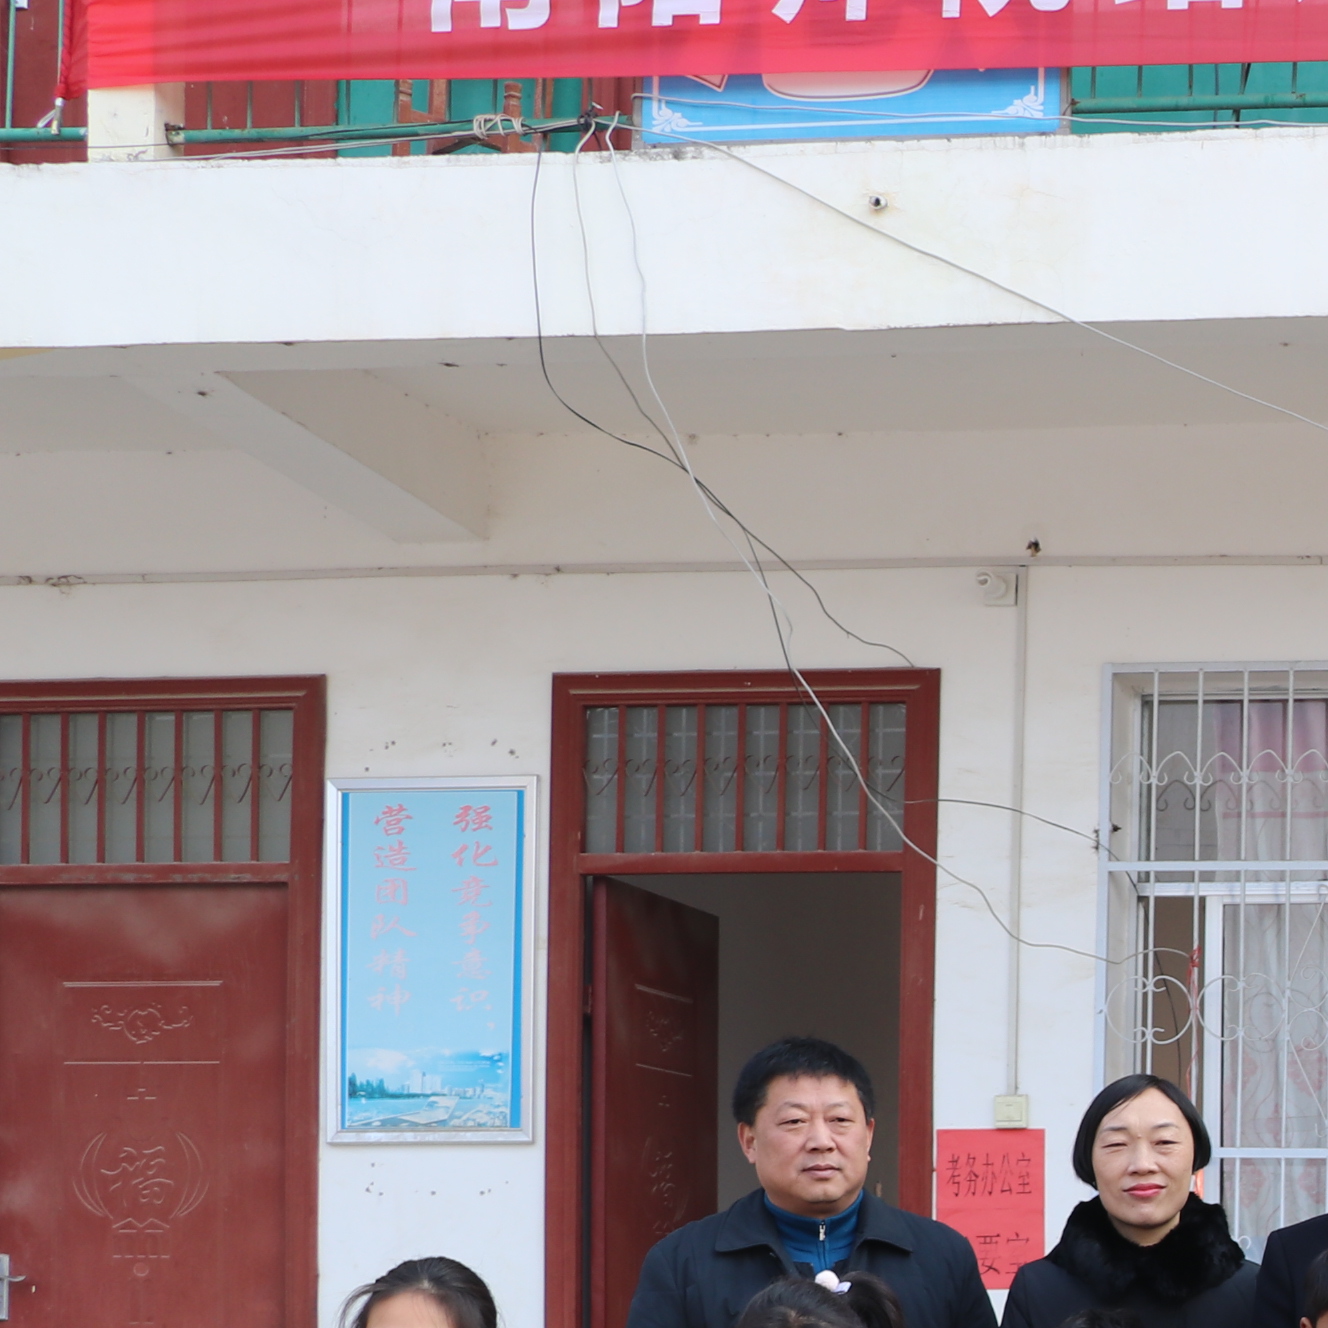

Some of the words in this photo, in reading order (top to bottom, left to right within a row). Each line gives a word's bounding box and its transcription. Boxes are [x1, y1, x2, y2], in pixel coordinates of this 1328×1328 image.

[367, 803, 417, 1016] 营造团队精神
[946, 1152, 1032, 1197] 考务办公室
[964, 1231, 1031, 1275] 要室
